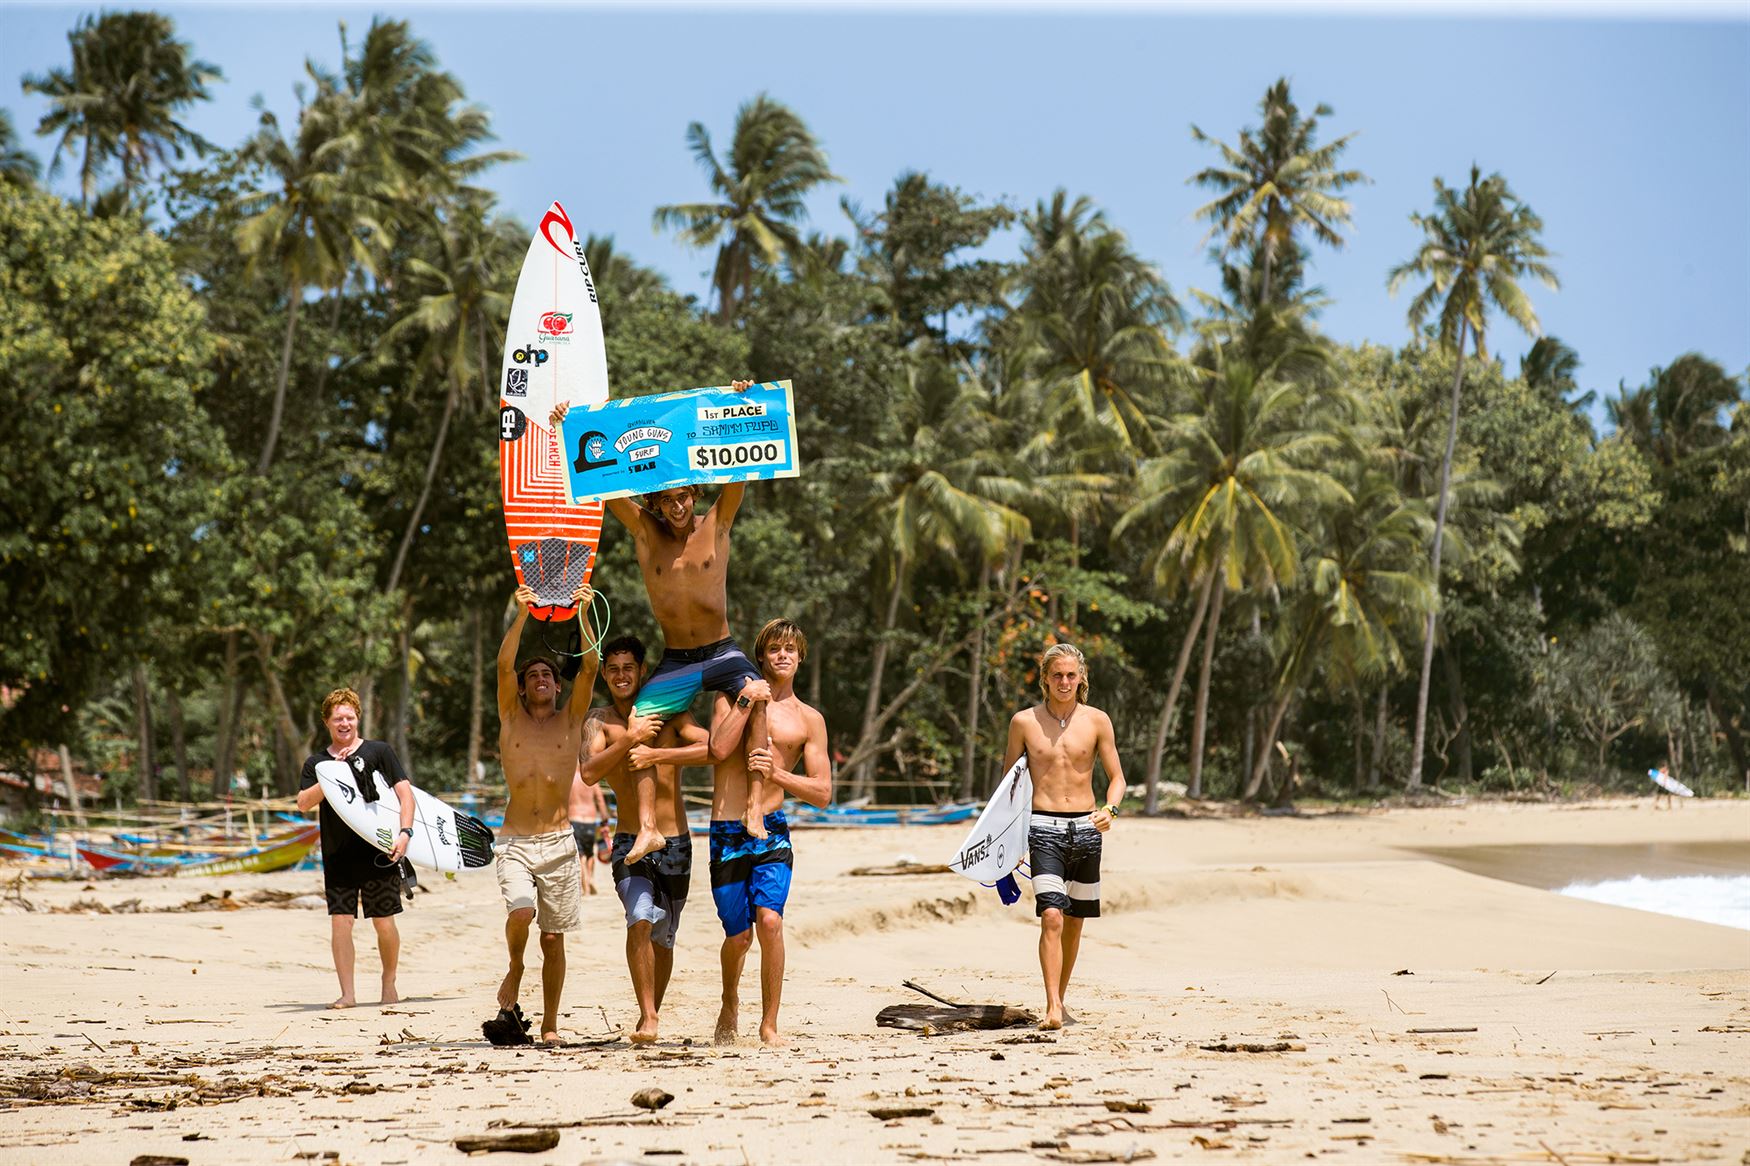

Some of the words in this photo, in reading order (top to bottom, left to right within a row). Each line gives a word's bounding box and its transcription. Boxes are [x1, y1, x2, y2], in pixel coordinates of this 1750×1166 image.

[585, 278, 598, 303] RIP
[723, 406, 763, 418] PLACE
[618, 429, 644, 449] YOUNG
[646, 428, 669, 441] GUNS
[635, 447, 655, 459] SURF
[696, 444, 778, 468] $10,000
[961, 839, 986, 870] VANS
